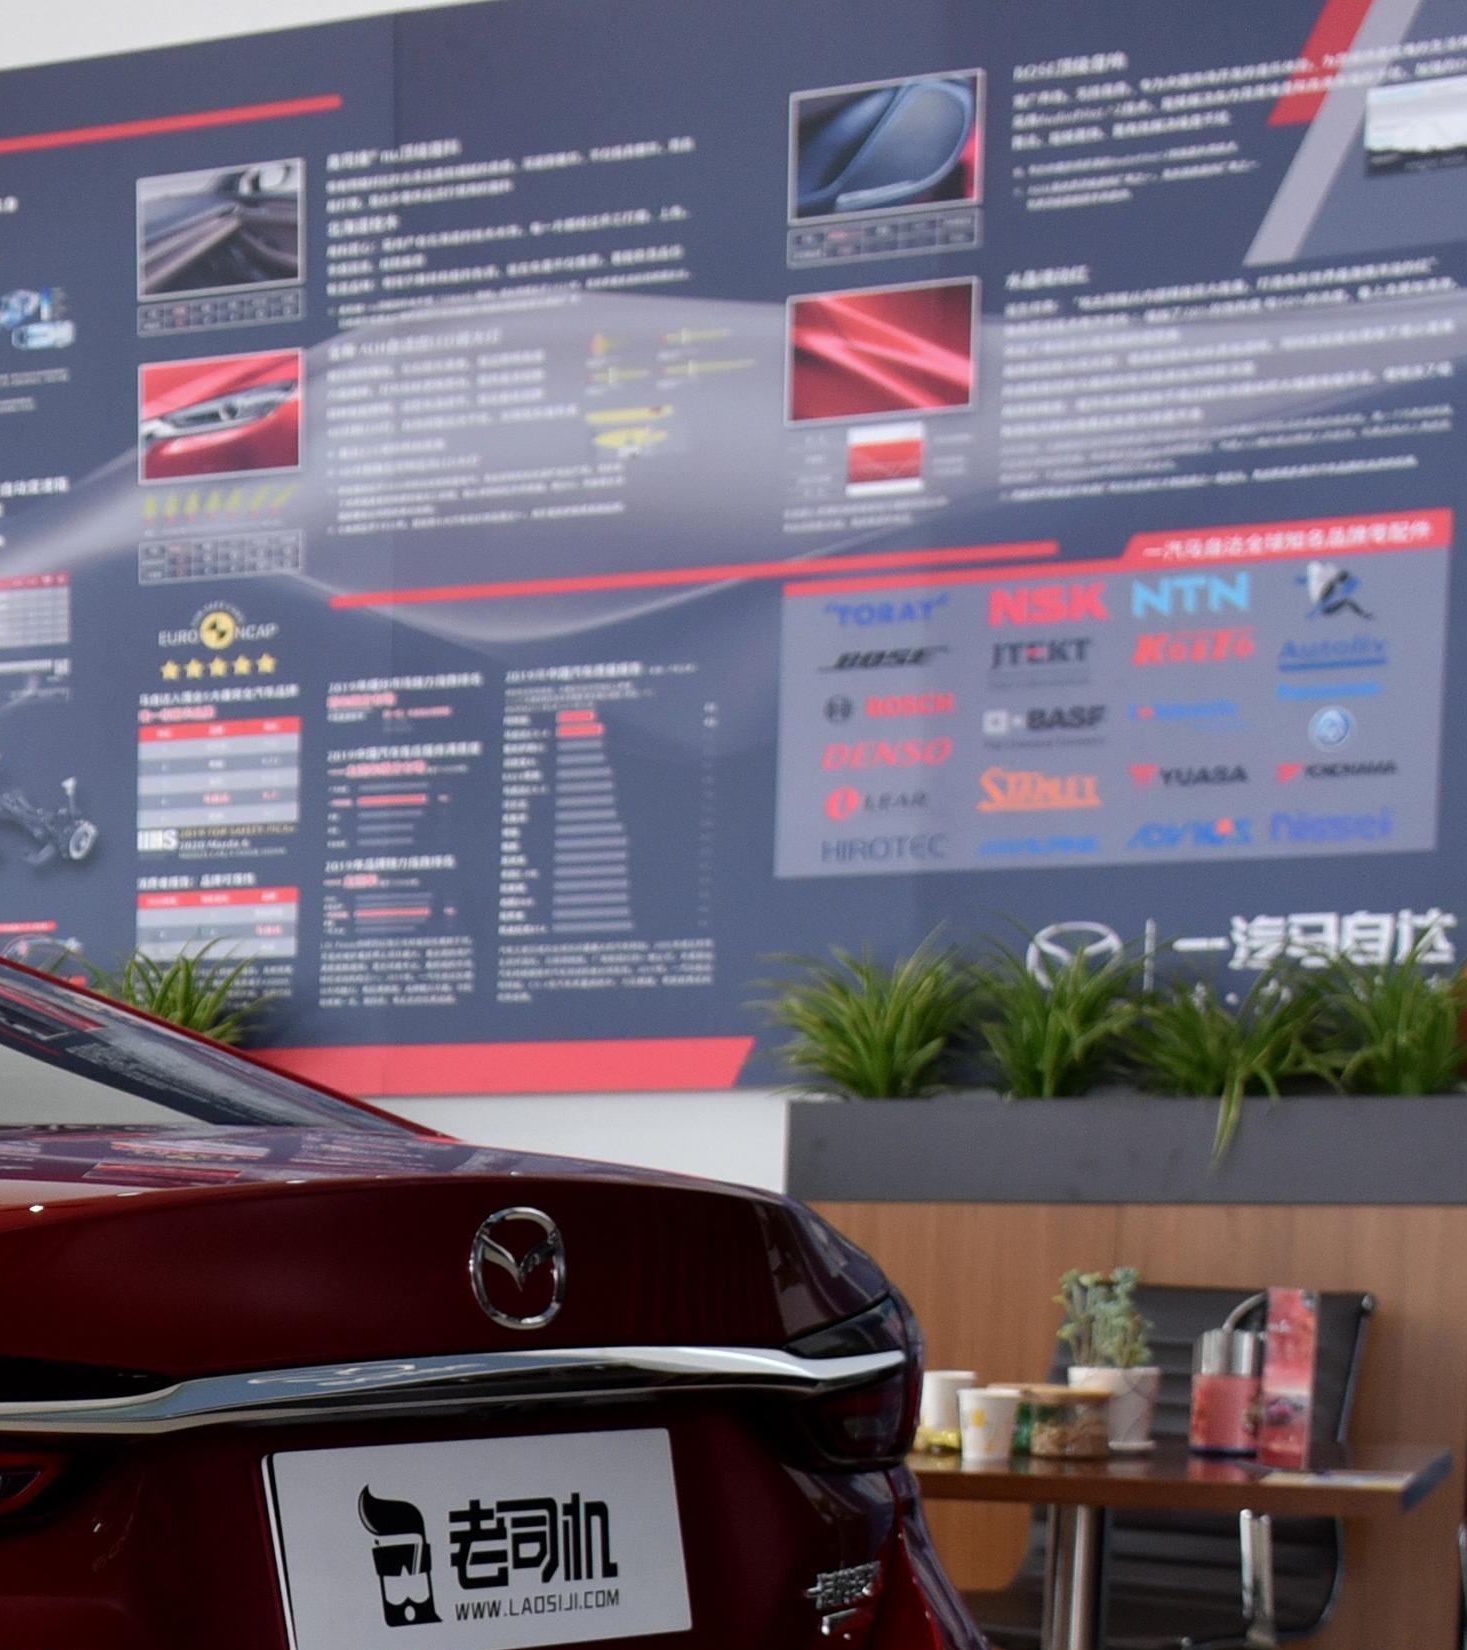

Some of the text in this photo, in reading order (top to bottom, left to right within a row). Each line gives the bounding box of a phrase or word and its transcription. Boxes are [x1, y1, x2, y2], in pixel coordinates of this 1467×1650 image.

[988, 582, 1110, 628] NSK
[1131, 571, 1251, 618] NTN
[158, 622, 279, 647] EURO NCAP
[992, 637, 1091, 668] JTEKT
[865, 693, 955, 718] BOSCH
[1025, 705, 1106, 730] BASF
[822, 736, 954, 771] DENSO
[1160, 764, 1250, 786] YUASA
[821, 834, 947, 862] HIROTEC
[1172, 907, 1458, 970] 一汽马自达
[448, 1492, 619, 1590] 老司机
[455, 1589, 620, 1622] WWW.LAOSIJI.COM
